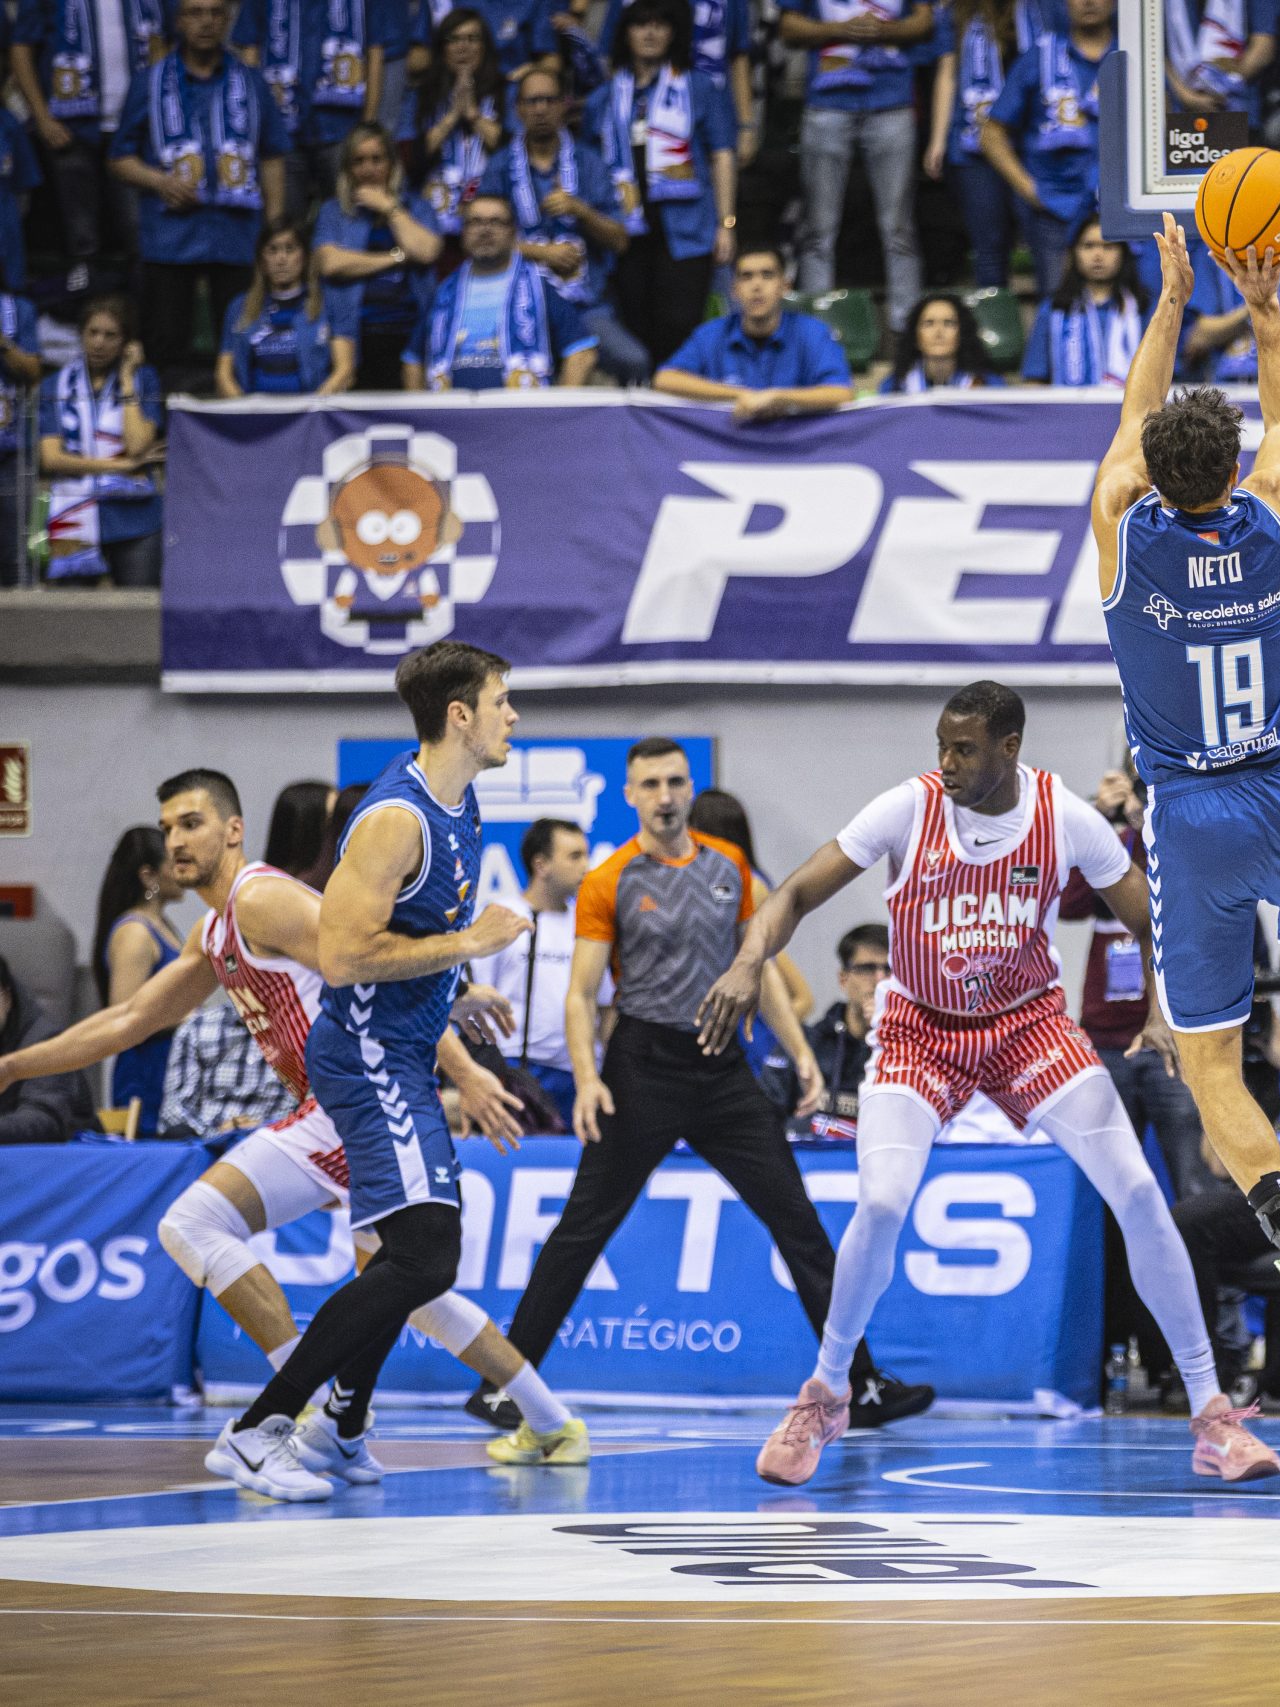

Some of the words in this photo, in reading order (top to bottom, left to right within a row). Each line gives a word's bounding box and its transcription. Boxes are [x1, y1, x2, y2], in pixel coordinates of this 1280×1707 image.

[1169, 129, 1205, 148] liga
[1169, 147, 1235, 164] endes
[1188, 552, 1243, 588] NETO
[1186, 602, 1254, 621] recoletas
[1186, 637, 1265, 749] 19
[924, 892, 1037, 934] UCAM
[942, 929, 1018, 953] MURCIA
